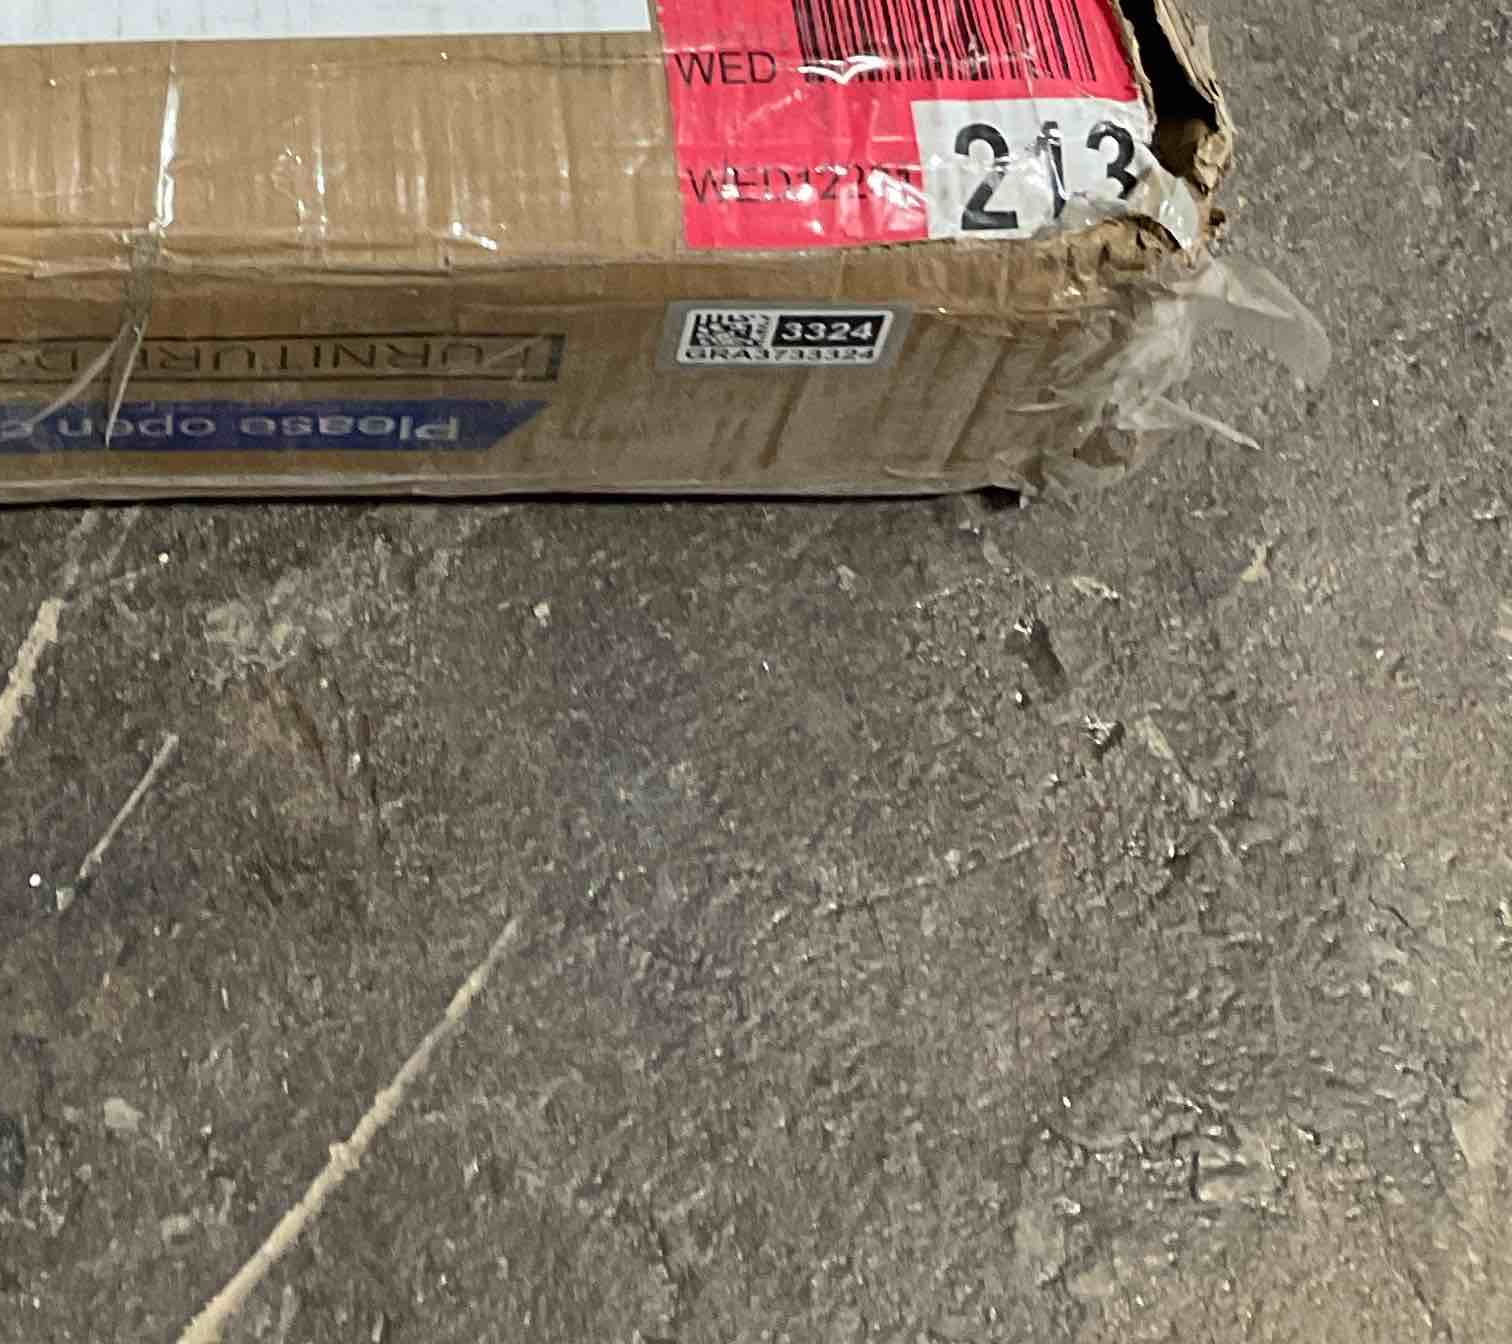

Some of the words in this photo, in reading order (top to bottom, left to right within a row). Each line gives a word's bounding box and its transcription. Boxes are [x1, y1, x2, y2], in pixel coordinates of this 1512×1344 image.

[675, 51, 778, 85] WED
[955, 119, 1137, 231] 213
[781, 321, 873, 341] 3324
[57, 414, 215, 442] open
[240, 414, 458, 441] Please
